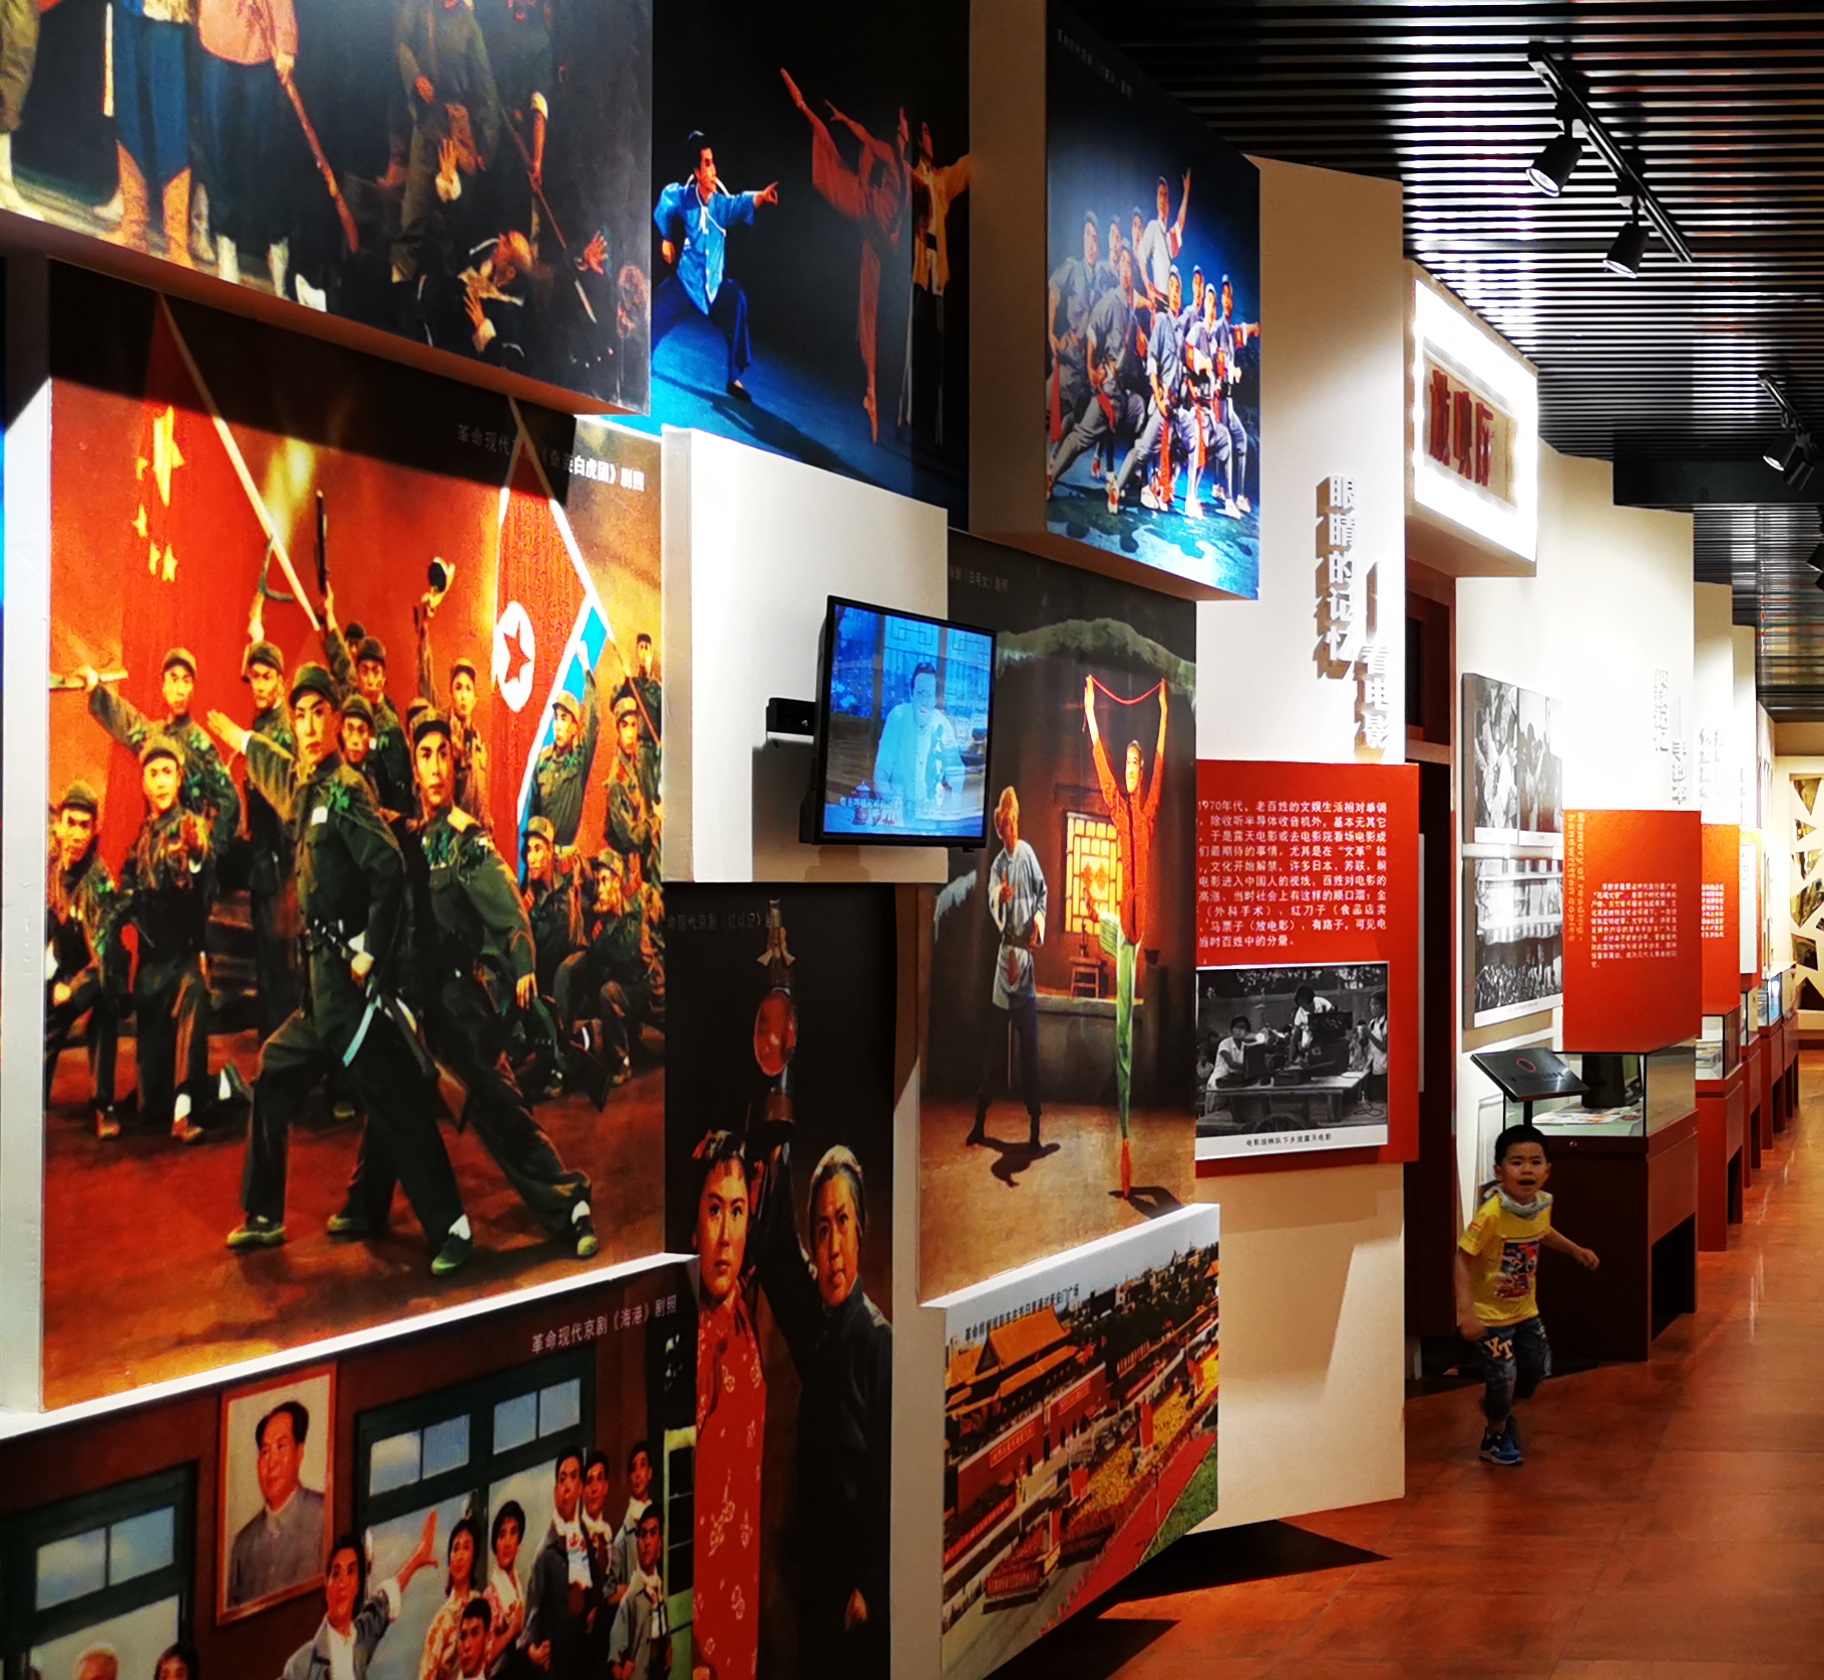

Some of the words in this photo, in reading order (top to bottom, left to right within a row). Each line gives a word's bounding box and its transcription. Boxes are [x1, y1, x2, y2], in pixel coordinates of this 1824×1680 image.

[457, 424, 645, 492] 革命现代《奇袭白虎团》剧照
